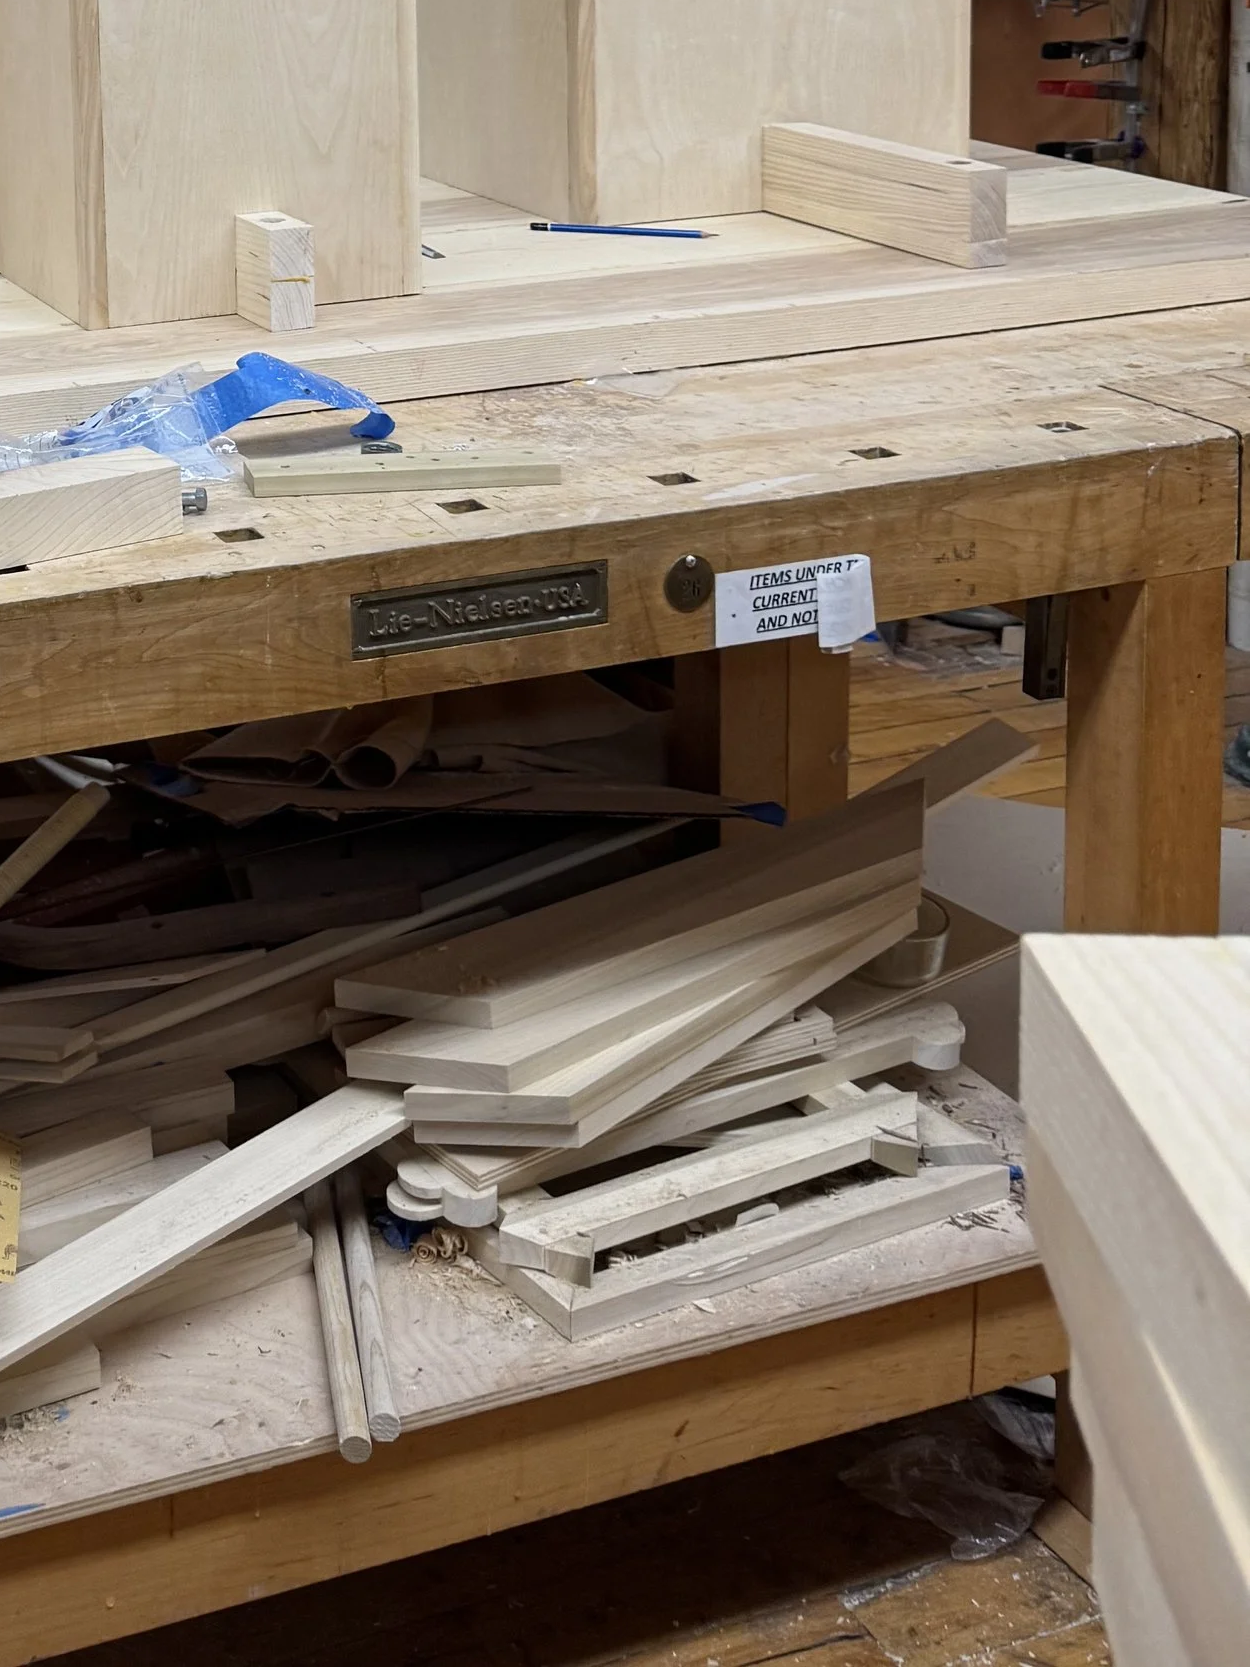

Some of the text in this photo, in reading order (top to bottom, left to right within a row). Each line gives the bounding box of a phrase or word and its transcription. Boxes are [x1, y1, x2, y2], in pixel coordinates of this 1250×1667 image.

[750, 569, 792, 589] ITEMS
[756, 609, 819, 632] AND NOT
